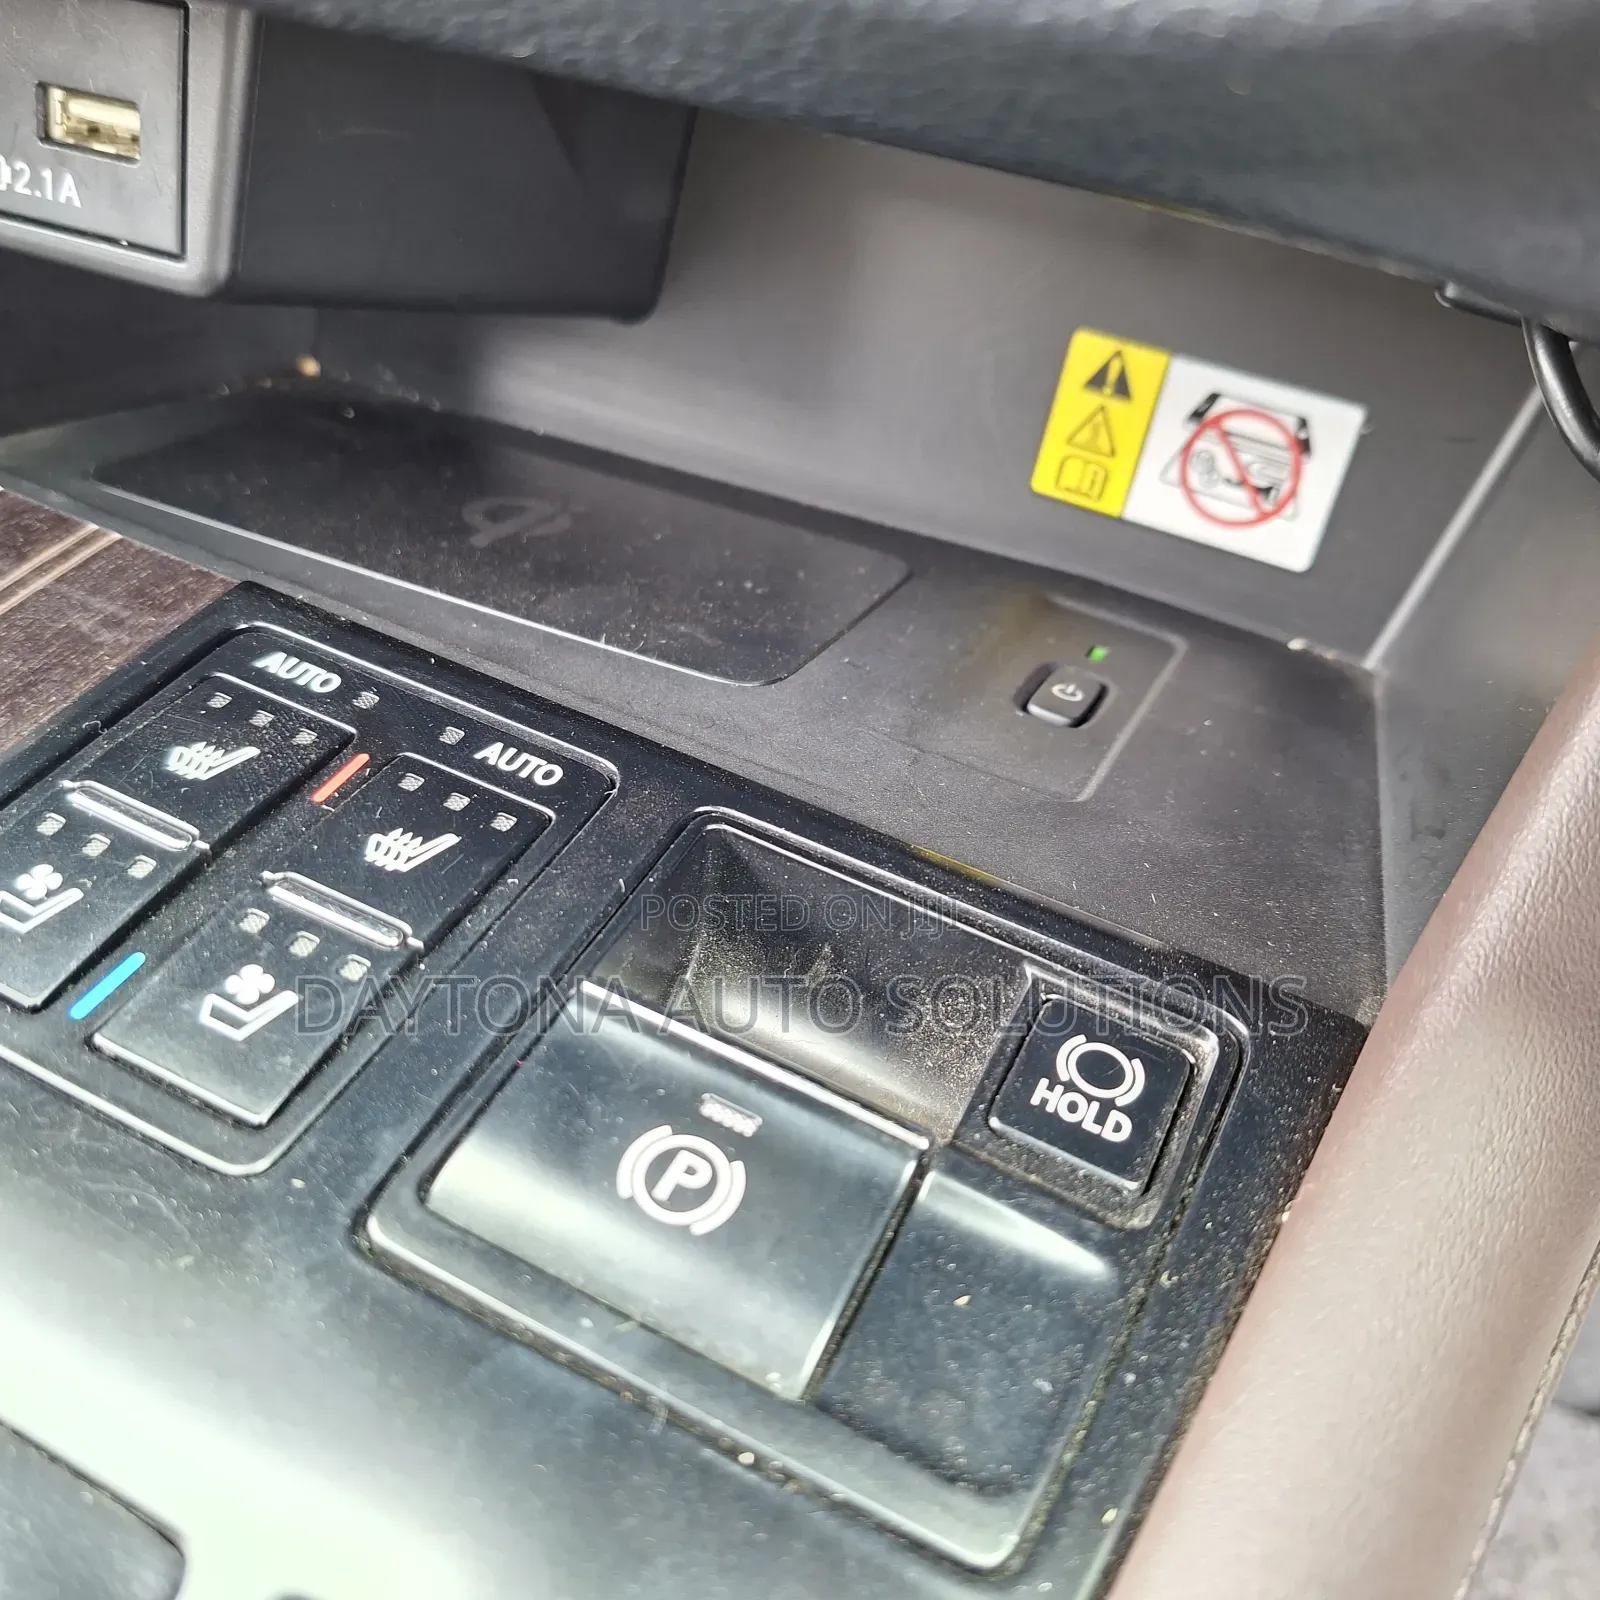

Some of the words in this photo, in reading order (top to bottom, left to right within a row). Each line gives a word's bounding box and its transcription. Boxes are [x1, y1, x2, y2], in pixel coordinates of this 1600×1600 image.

[252, 651, 342, 694] AUTO
[474, 741, 564, 786] AUTO
[1029, 1078, 1133, 1143] HOLD
[651, 1149, 713, 1201] P
